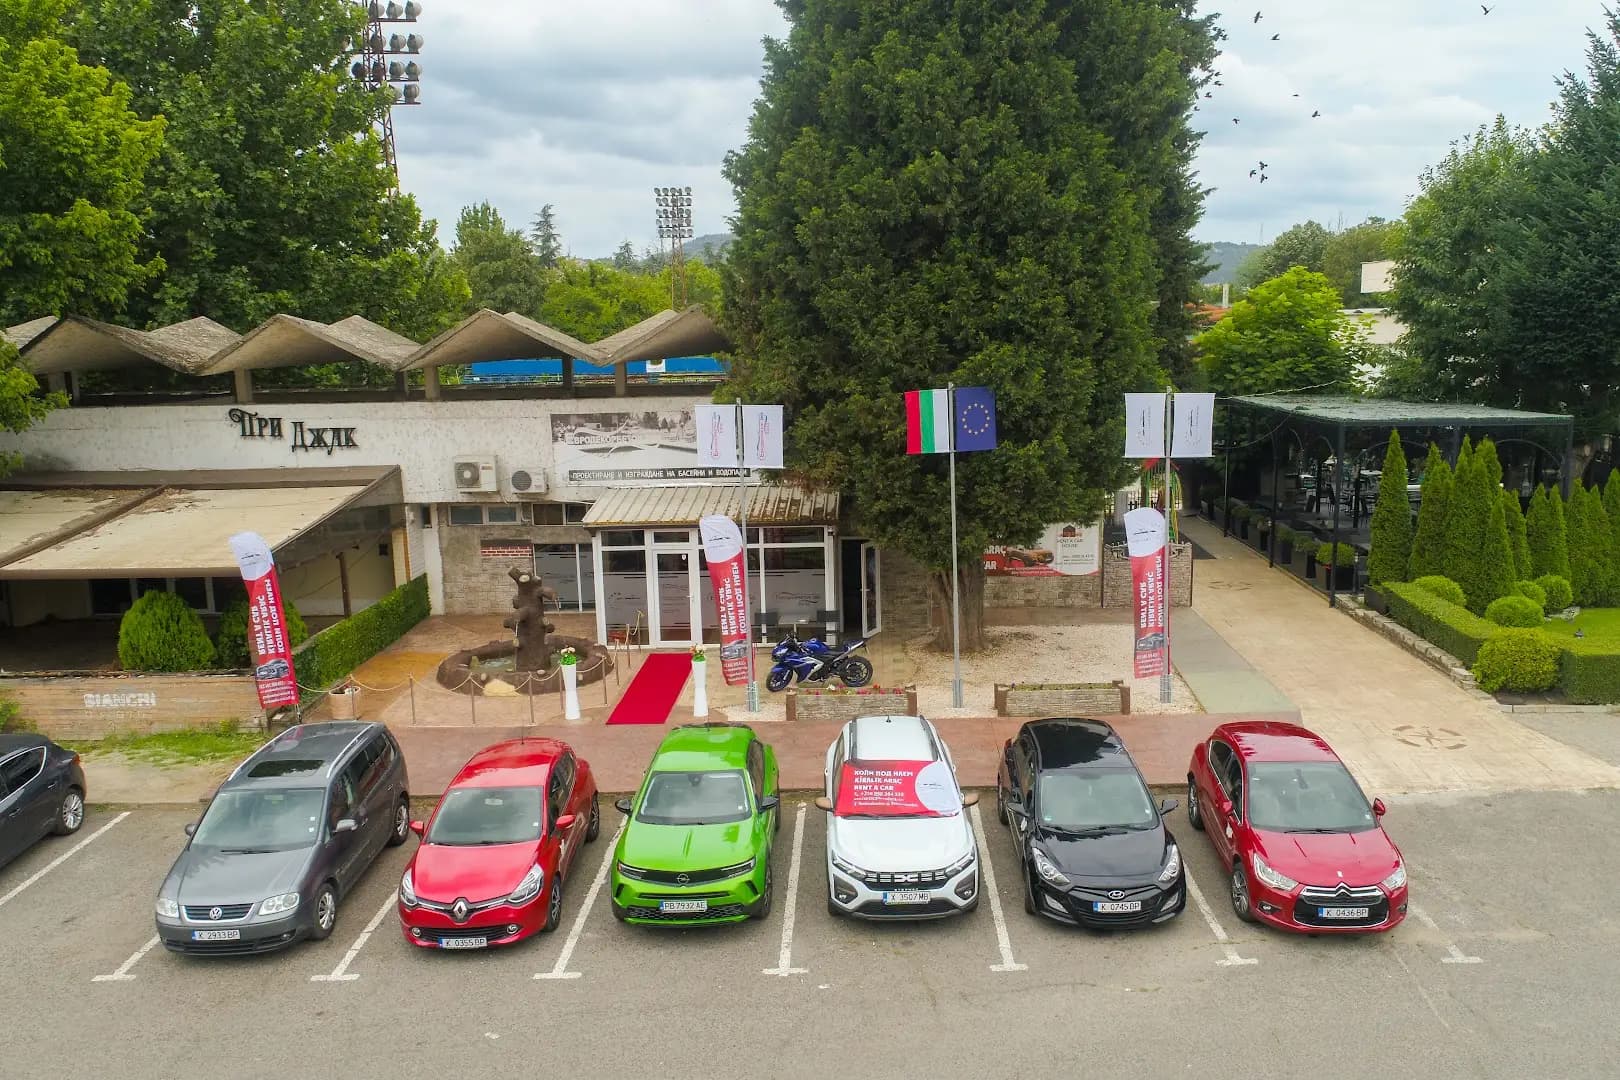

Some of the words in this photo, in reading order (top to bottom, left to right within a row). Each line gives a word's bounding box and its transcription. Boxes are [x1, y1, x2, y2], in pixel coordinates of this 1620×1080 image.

[625, 470, 664, 478] ИЗГРАЖДАНЕ
[678, 468, 706, 477] БАСЕЙНИ
[708, 469, 713, 477] И
[715, 468, 749, 477] ВОДОПАИ
[984, 560, 997, 570] AR
